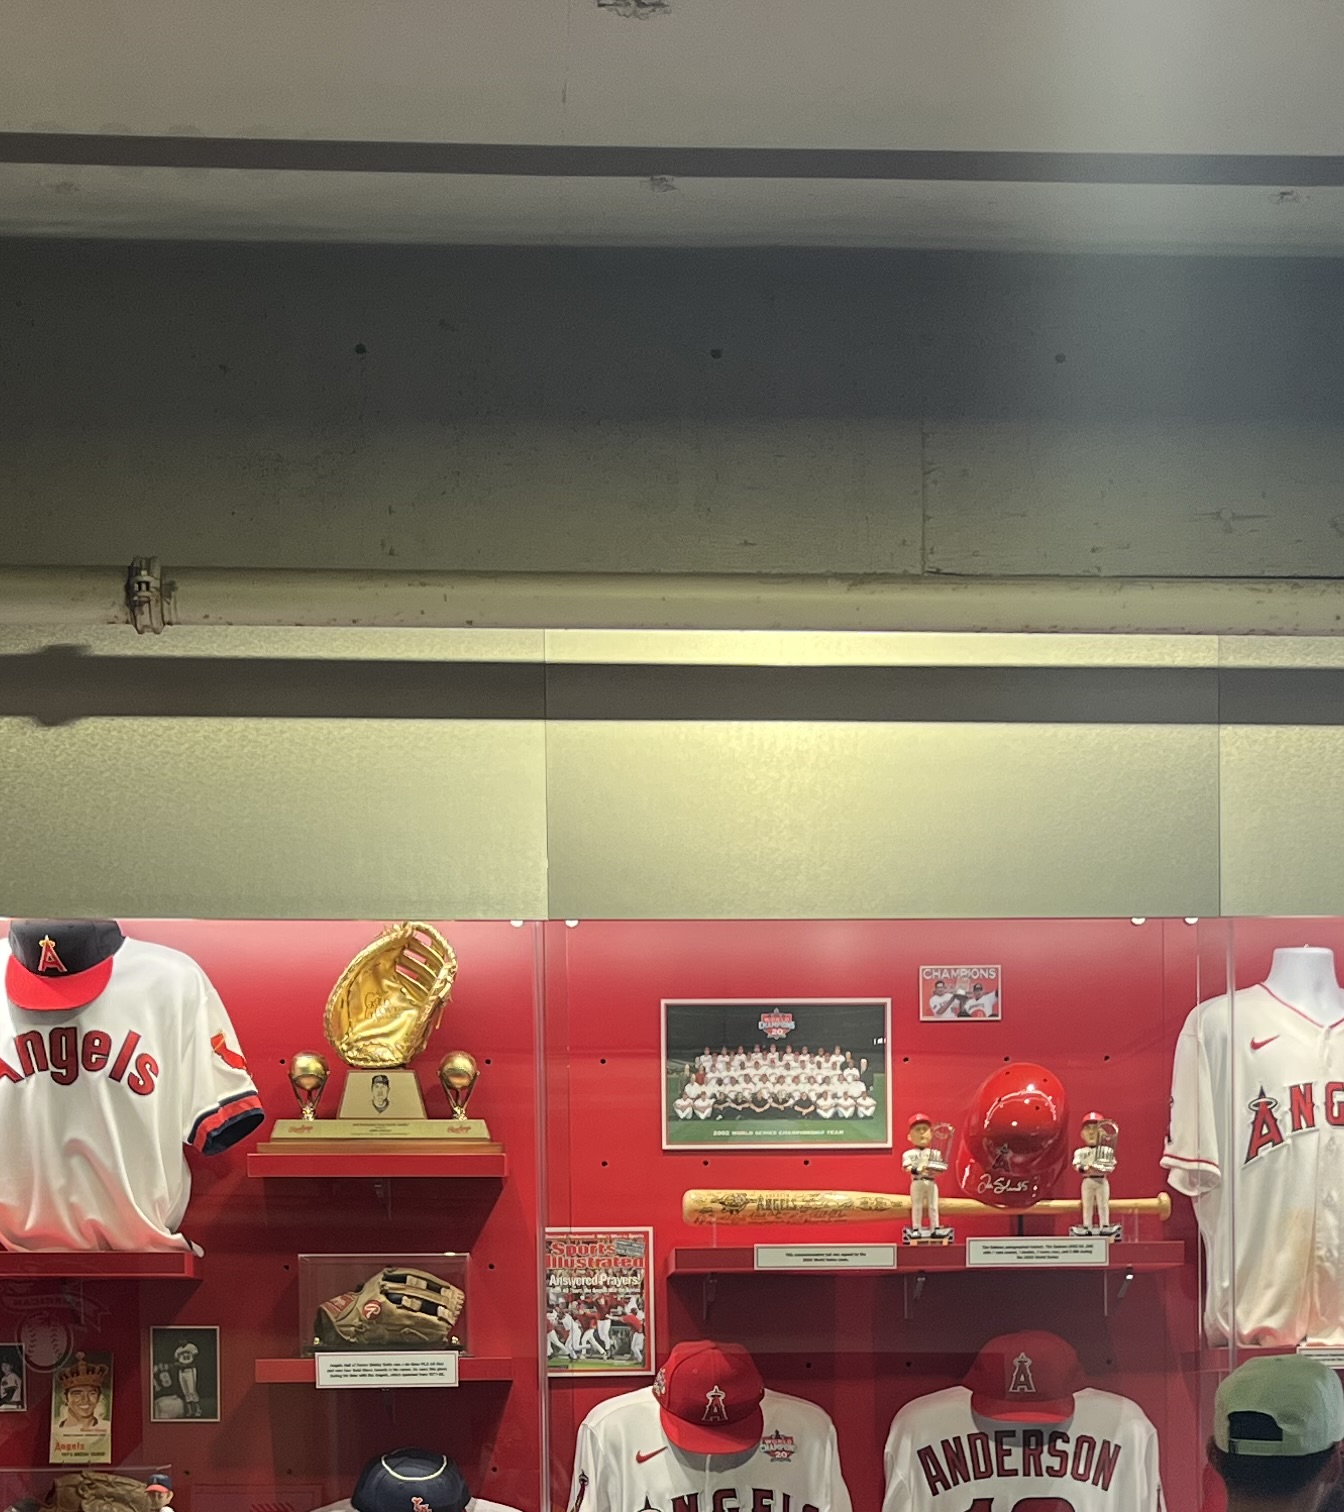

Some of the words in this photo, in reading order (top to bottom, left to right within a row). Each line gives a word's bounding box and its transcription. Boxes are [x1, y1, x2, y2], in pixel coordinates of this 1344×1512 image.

[38, 935, 68, 972] A
[922, 968, 997, 980] CHAMPIONS
[545, 1254, 646, 1269] Illustrated
[551, 1242, 616, 1257] Sports
[549, 1274, 599, 1287] Answered
[599, 1273, 642, 1289] Prayers!
[1009, 1352, 1036, 1392] A
[702, 1385, 728, 1420] A
[916, 1429, 1122, 1497] ANDERSON
